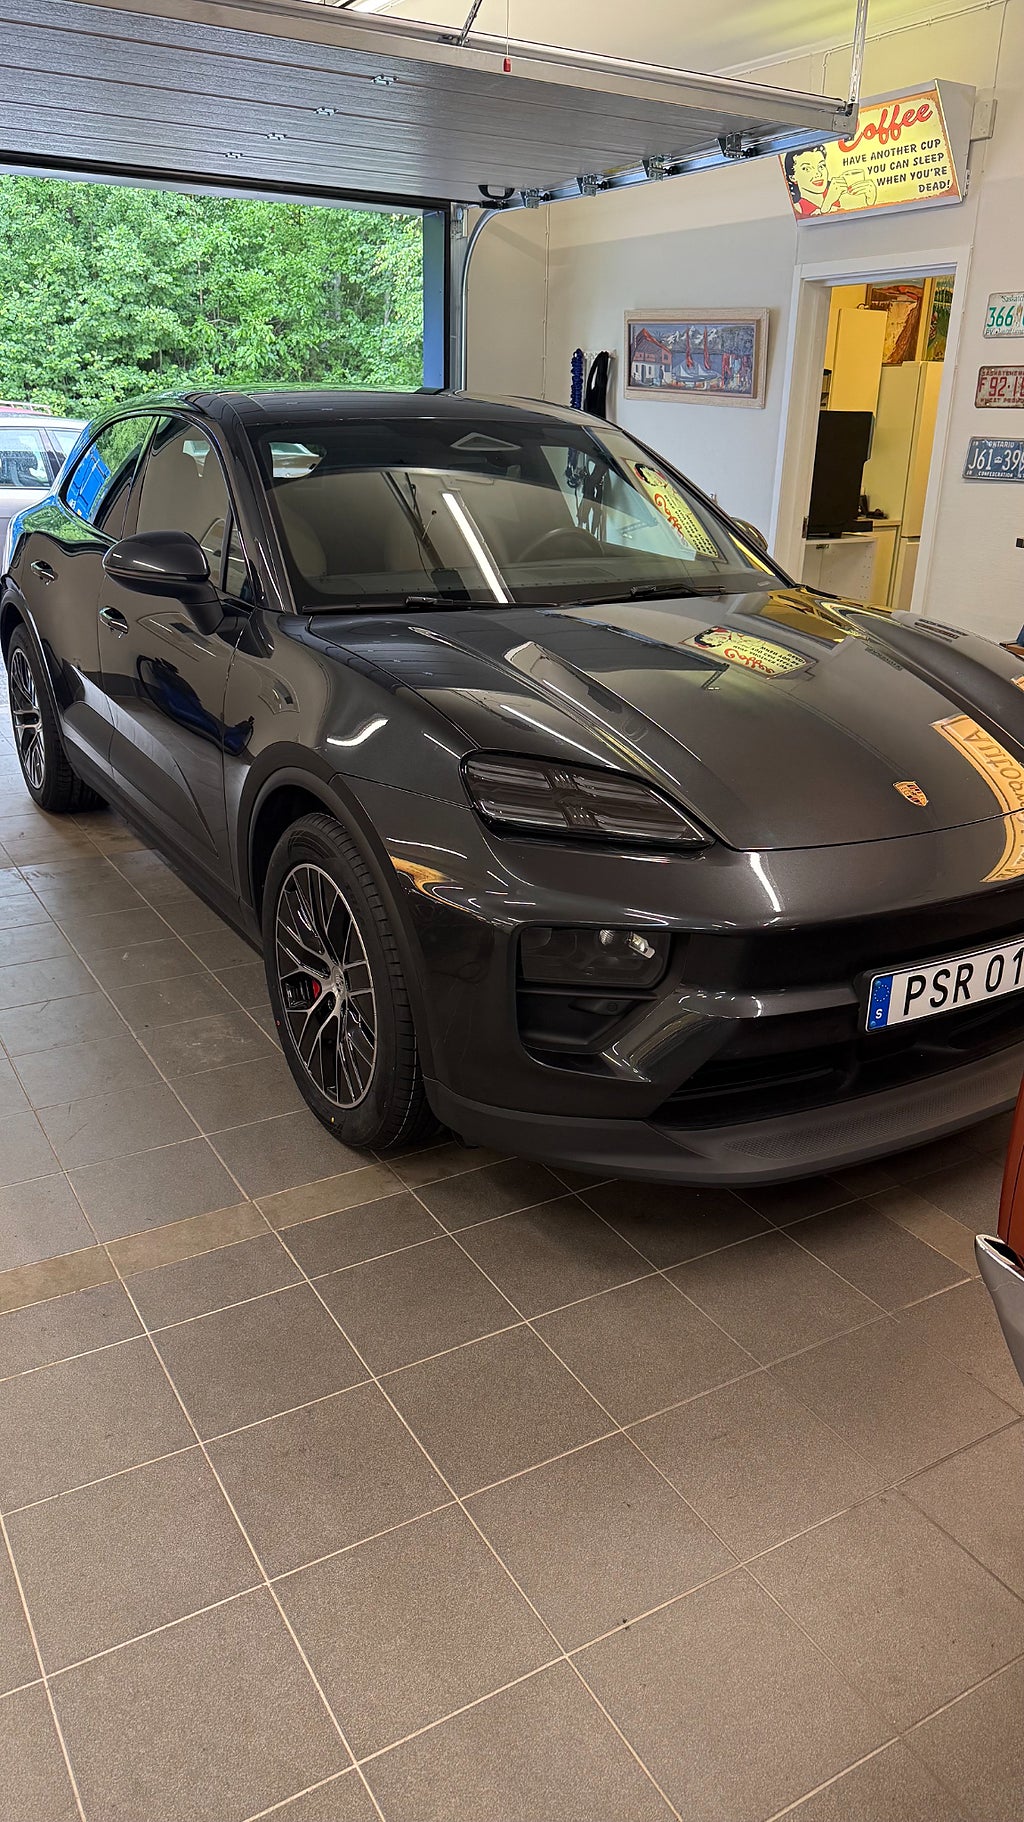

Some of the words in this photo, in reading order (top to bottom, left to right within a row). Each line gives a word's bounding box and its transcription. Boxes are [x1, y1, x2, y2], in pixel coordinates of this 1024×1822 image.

[843, 154, 867, 166] HAVE
[870, 143, 917, 160] ANOTHER
[920, 138, 941, 150] CUP
[867, 163, 886, 174] YOU
[889, 159, 909, 170] CAN
[913, 152, 944, 166] SLEEP
[876, 173, 907, 186] WHEN
[910, 166, 947, 180] YOU'RE
[918, 179, 951, 192] DEAD!
[986, 305, 1015, 327] 366
[968, 448, 994, 470] J61
[903, 962, 974, 1016] PSR
[985, 946, 1024, 993] 01
[875, 1008, 883, 1019] S
